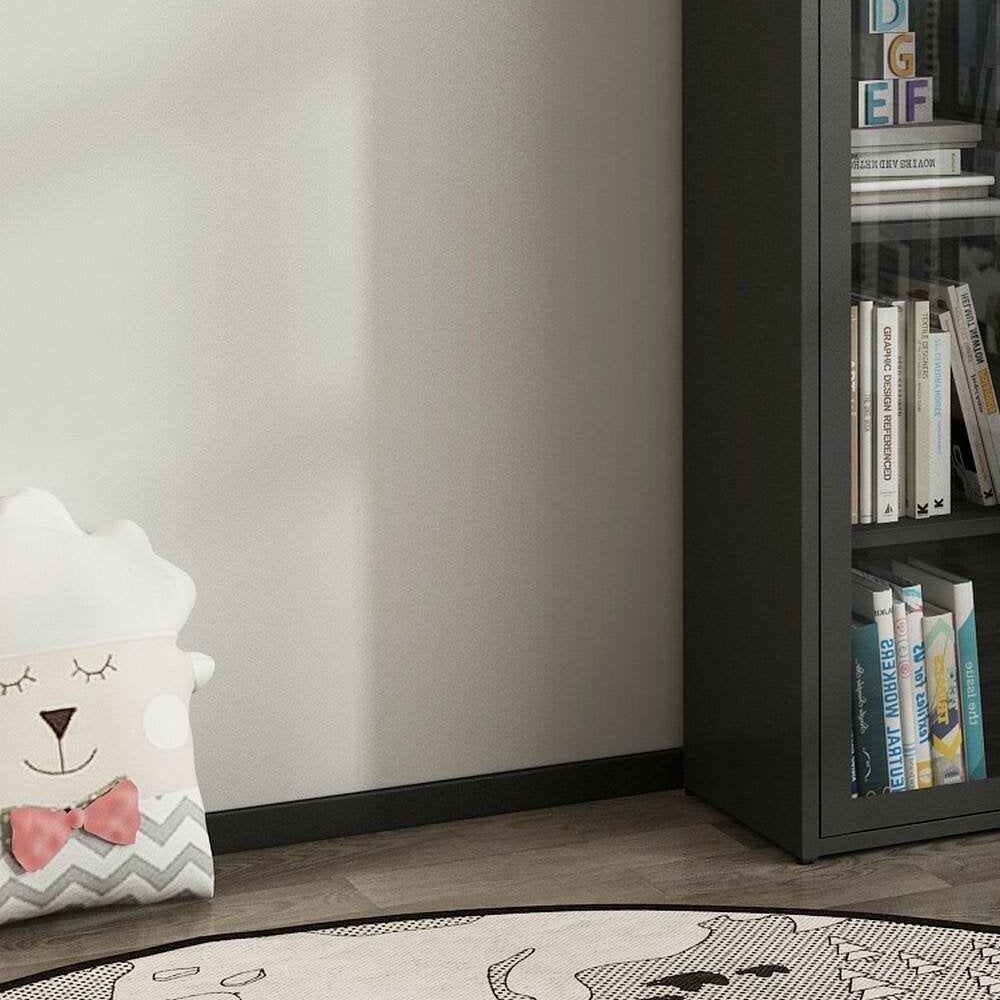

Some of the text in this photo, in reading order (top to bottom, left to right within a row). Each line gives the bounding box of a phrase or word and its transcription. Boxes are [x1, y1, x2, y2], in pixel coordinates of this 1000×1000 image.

[888, 34, 914, 78] G
[865, 82, 889, 125] E
[906, 80, 928, 121] F
[851, 158, 936, 170] MOVIES AND METH
[883, 326, 892, 481] GRAPHIC DESIGN REFERENCED
